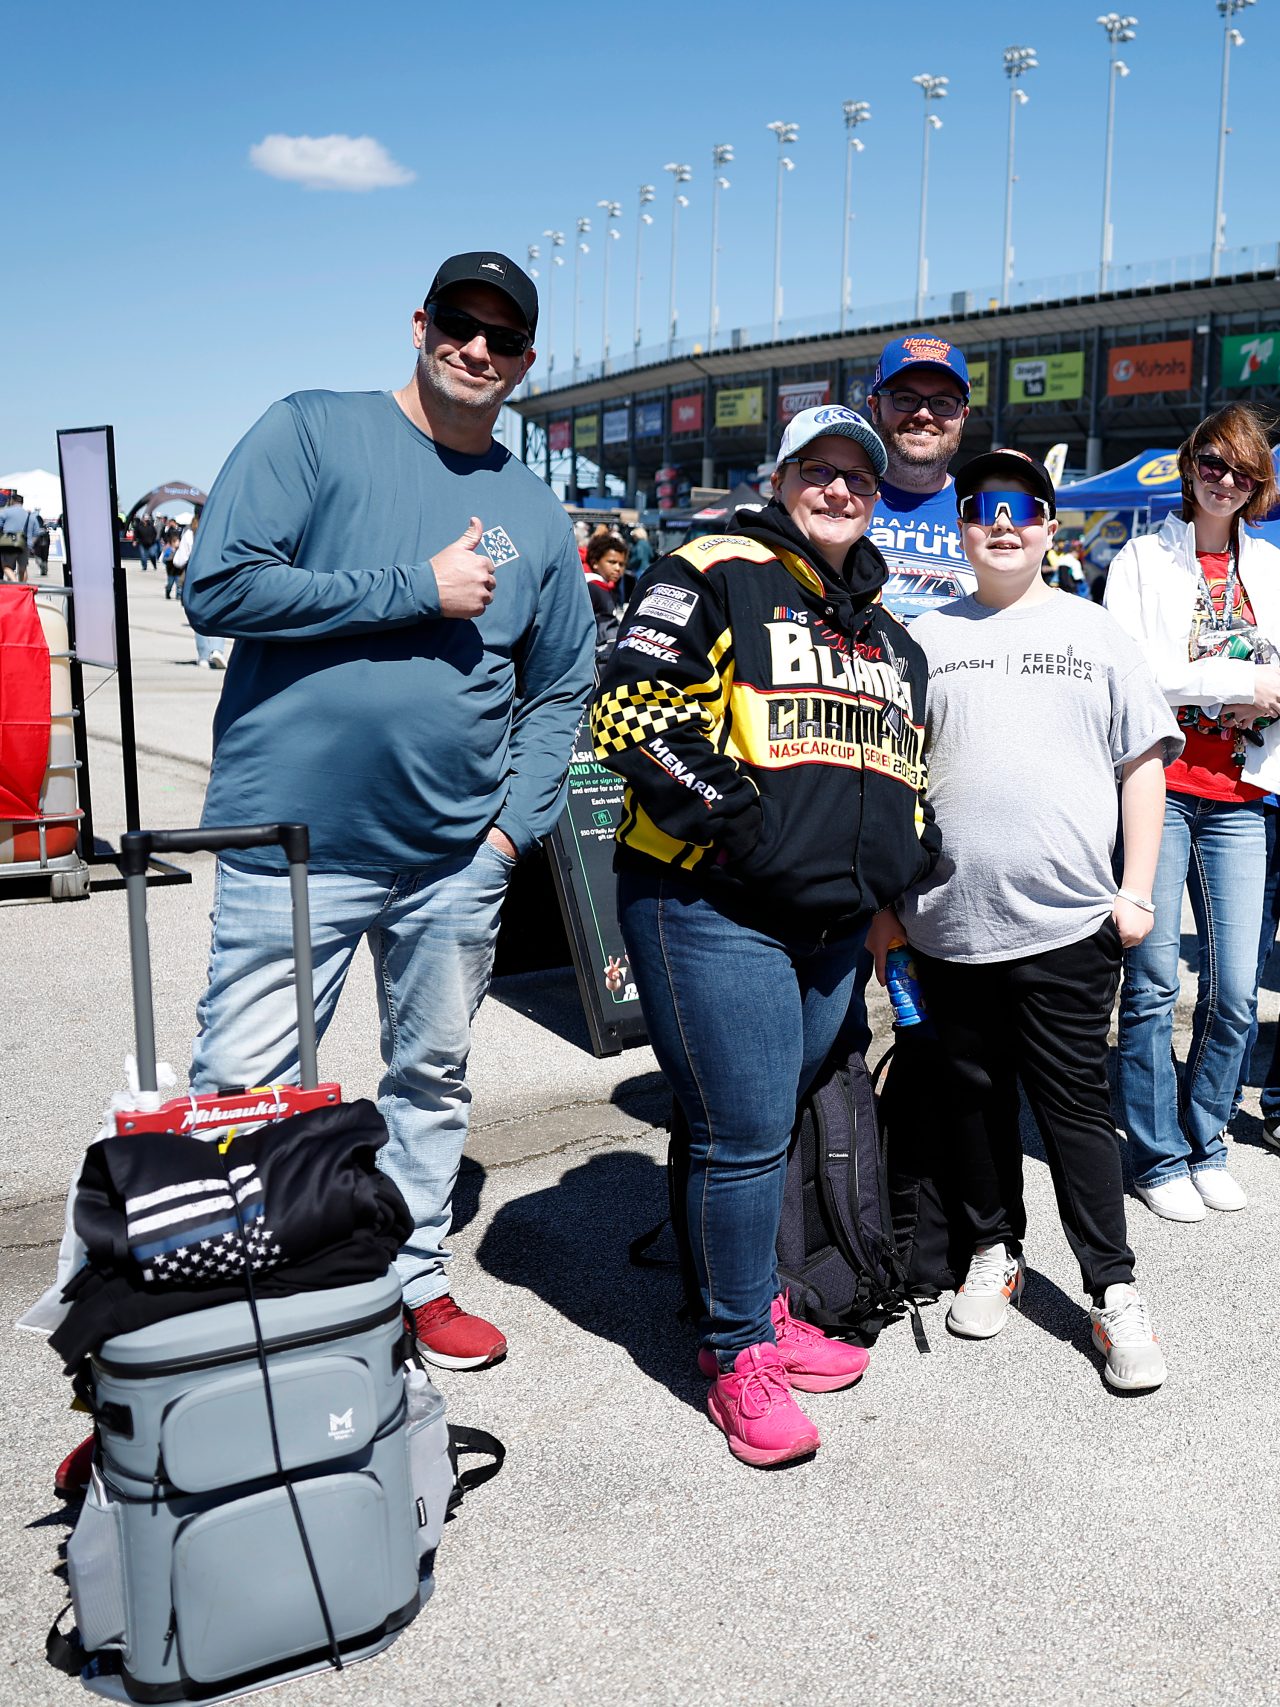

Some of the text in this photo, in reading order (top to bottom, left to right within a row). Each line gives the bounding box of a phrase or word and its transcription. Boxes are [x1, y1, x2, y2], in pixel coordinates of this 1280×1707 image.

[872, 516, 947, 535] RAJAH
[868, 527, 967, 560] arut
[651, 596, 683, 611] SERIES
[626, 626, 678, 647] TEAM
[617, 637, 678, 664] NSKE
[1022, 652, 1092, 672] FEEDING
[1020, 664, 1093, 683] AMERICA
[768, 741, 829, 759] NASCAR
[831, 745, 856, 761] CUP
[865, 747, 891, 768] SERIES
[568, 763, 591, 777] AND
[591, 797, 606, 806] Each
[606, 796, 622, 805] week
[180, 1101, 290, 1130] Milwaukee
